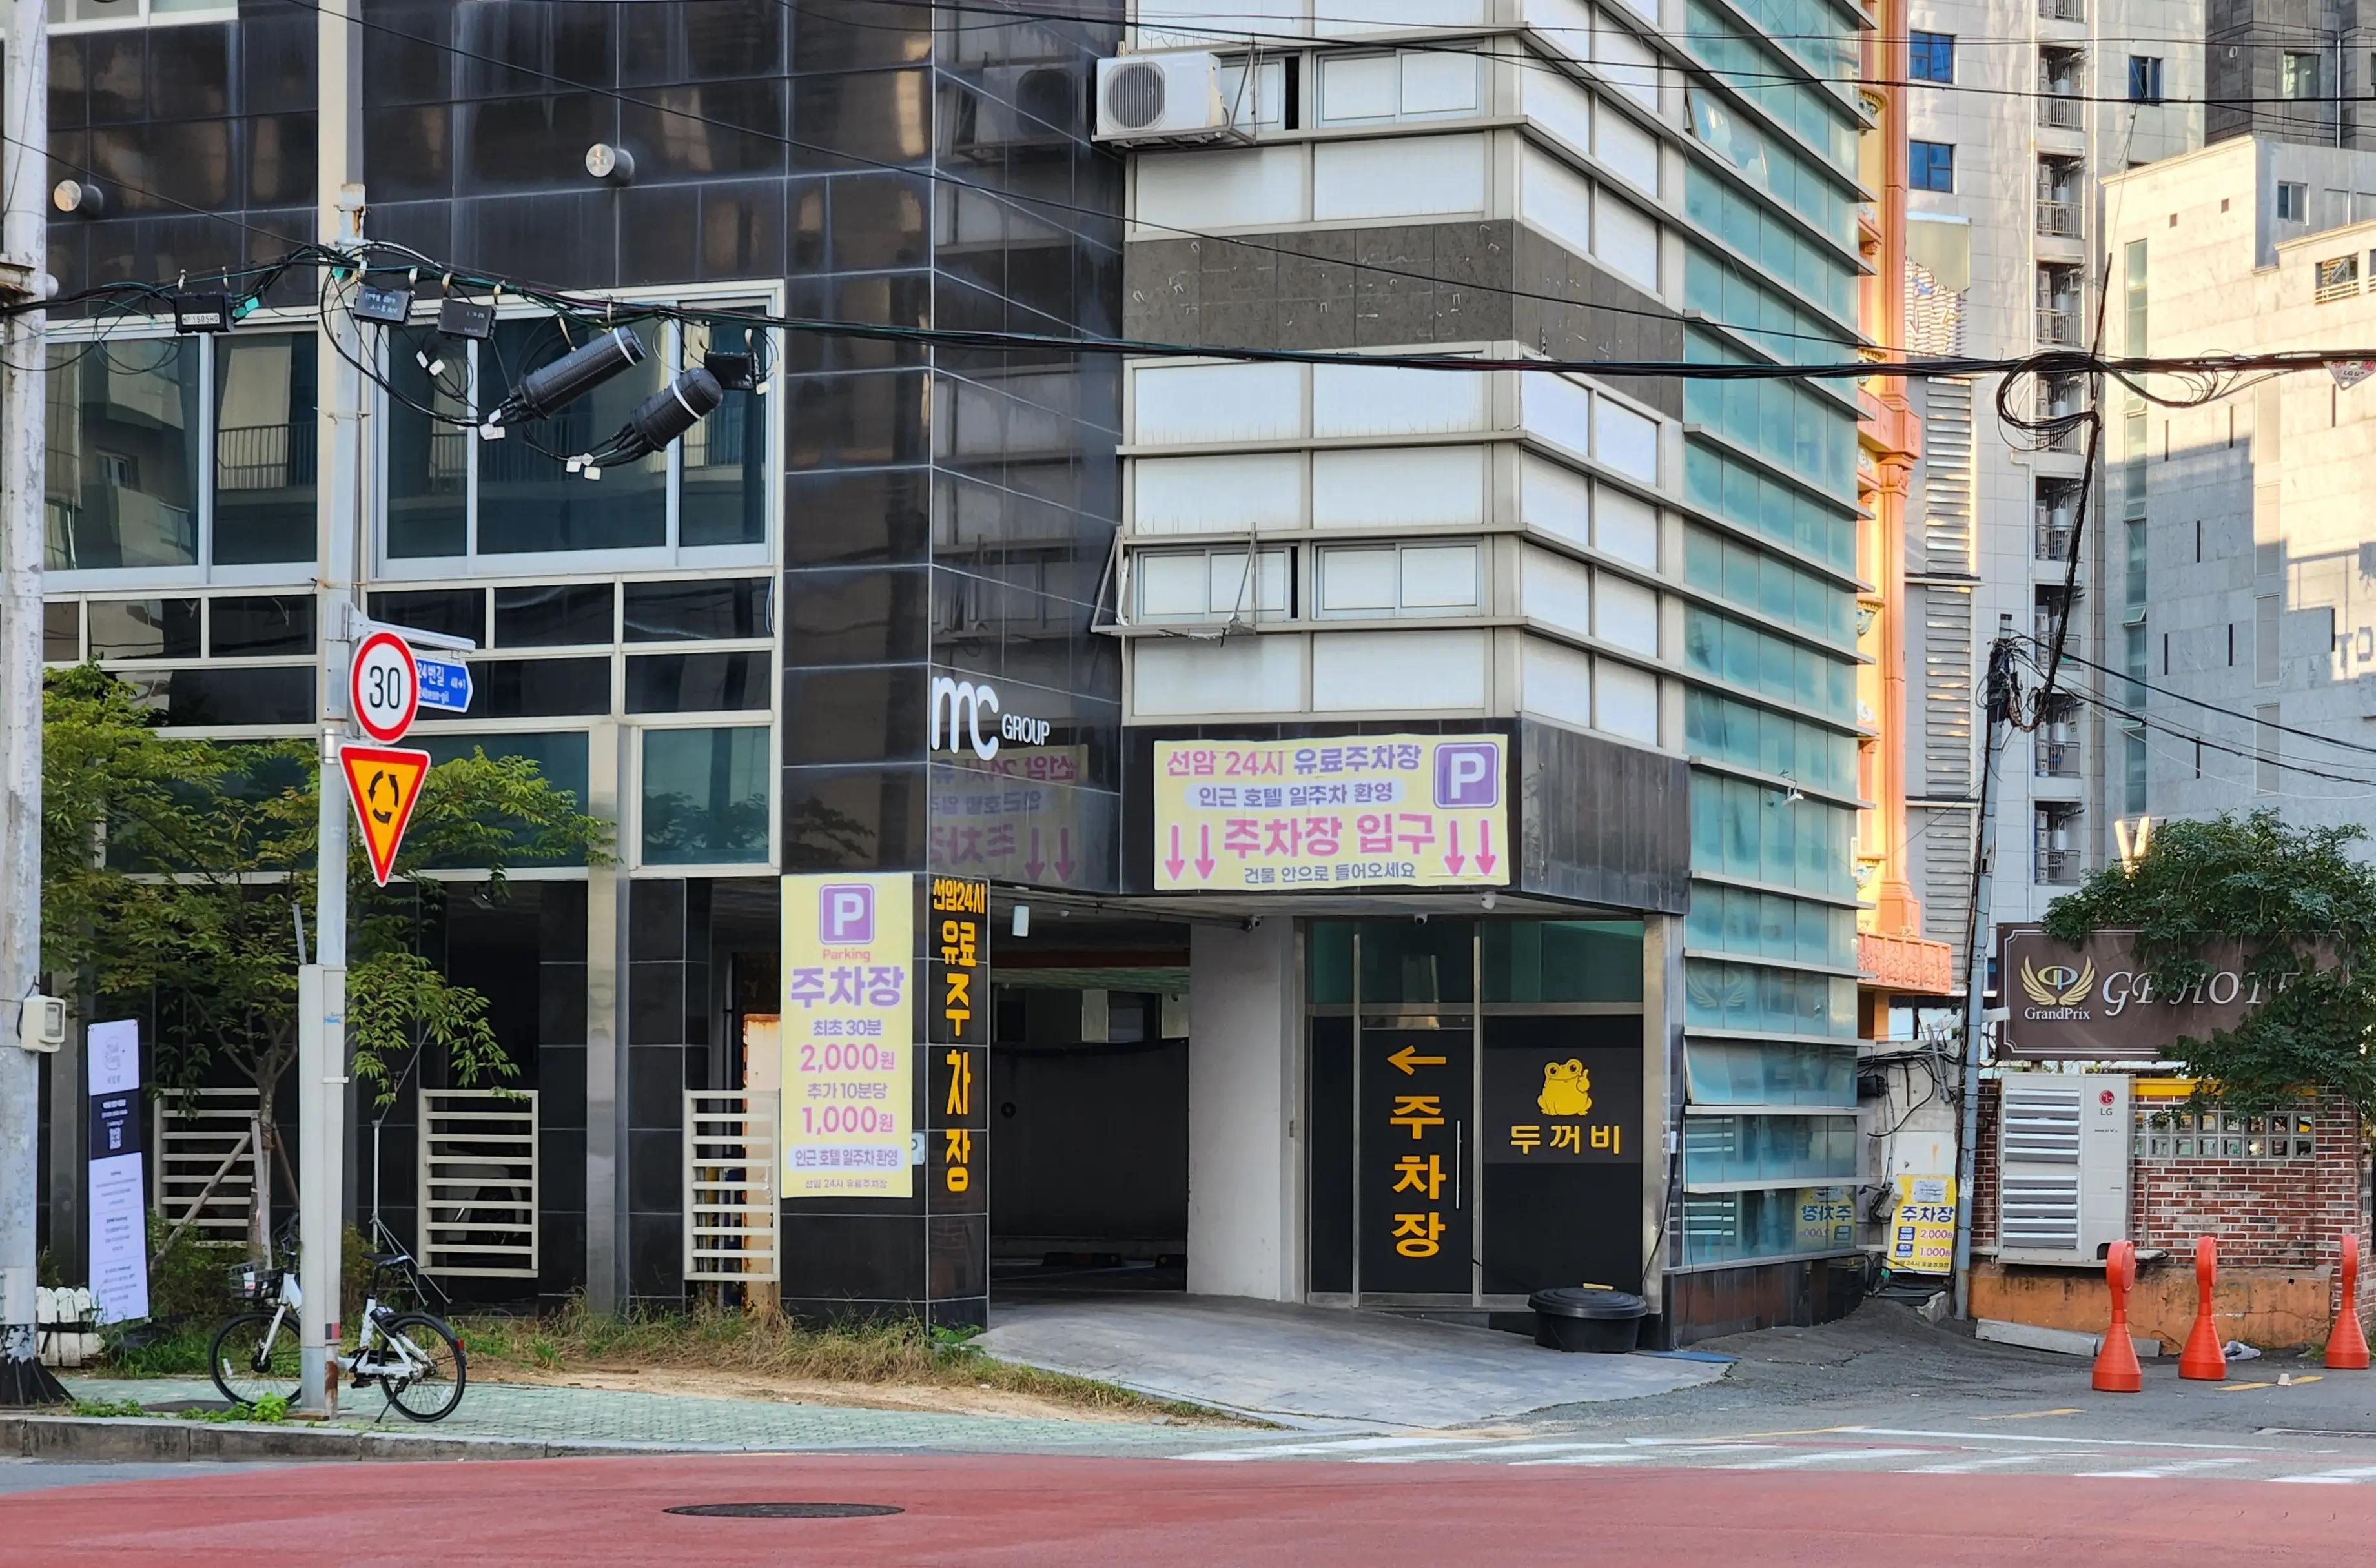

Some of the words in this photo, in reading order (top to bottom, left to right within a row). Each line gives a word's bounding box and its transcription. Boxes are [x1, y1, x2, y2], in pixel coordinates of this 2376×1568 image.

[369, 666, 402, 709] 30
[1001, 713, 1050, 746] GROUP
[1167, 751, 1217, 777] 선암
[1225, 751, 1284, 776] 24시
[1293, 744, 1422, 775] 유료주차장
[1199, 787, 1237, 808] 인근
[1244, 787, 1282, 808] 호텔
[1289, 785, 1347, 807] 일주차
[1354, 782, 1393, 804] 환영
[1224, 815, 1342, 859] 주차장
[1356, 813, 1435, 855] 입구
[1244, 867, 1276, 884] 건물
[1281, 866, 1329, 883] 안으로
[1335, 862, 1416, 881] 들어오세요
[932, 877, 985, 914] 선암24시
[823, 949, 870, 962] Parking
[790, 966, 905, 1009] 주차장
[2024, 1006, 2091, 1021] GrandPrix
[812, 1019, 843, 1037] 최초
[845, 1019, 882, 1037] 30분
[799, 1043, 896, 1074] 2,000원
[807, 1083, 838, 1099] 추가
[839, 1083, 888, 1099] 10분당
[802, 1106, 894, 1135] 1,000원
[2100, 1108, 2113, 1116] LG
[1510, 1125, 1620, 1154] 두꺼비
[795, 1149, 817, 1166] 인근
[819, 1149, 840, 1166] 호텔
[843, 1149, 874, 1166] 일주차
[876, 1149, 898, 1167] 환영
[824, 1179, 843, 1188] 24시
[1901, 1205, 1954, 1223] 주차장
